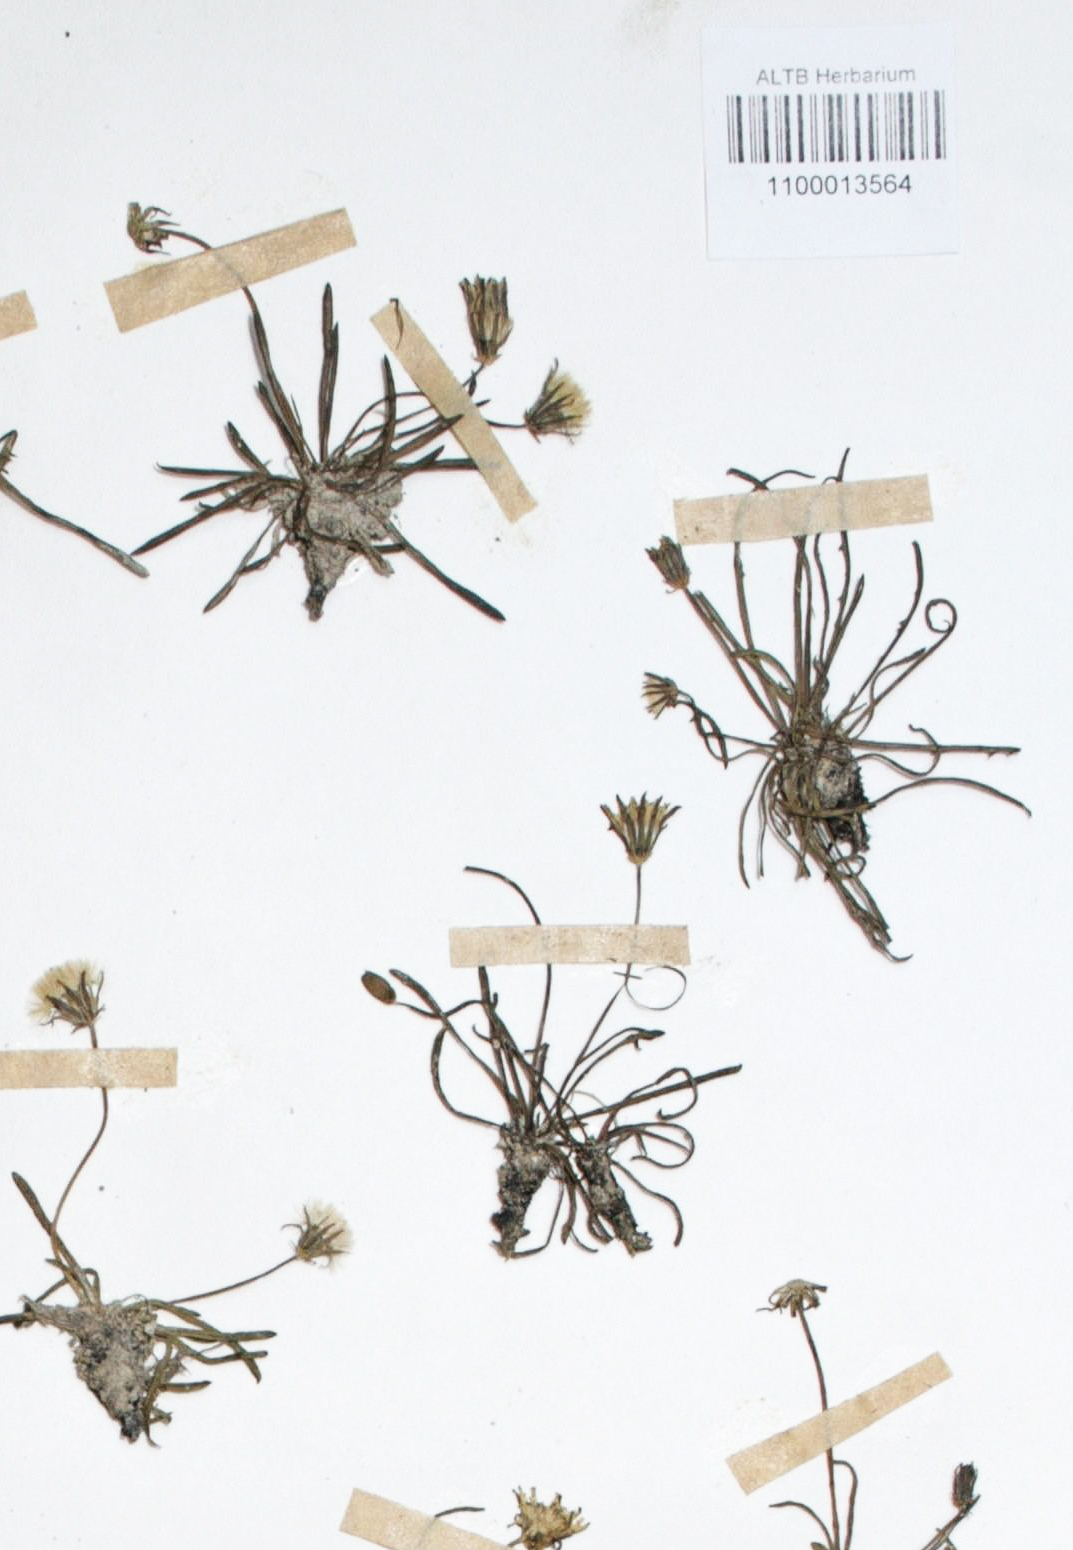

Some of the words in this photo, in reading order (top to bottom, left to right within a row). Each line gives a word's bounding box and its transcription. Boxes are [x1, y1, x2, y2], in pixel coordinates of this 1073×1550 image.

[756, 68, 809, 86] ALTB
[816, 67, 916, 85] Herbarium
[768, 174, 912, 196] 1100013564
